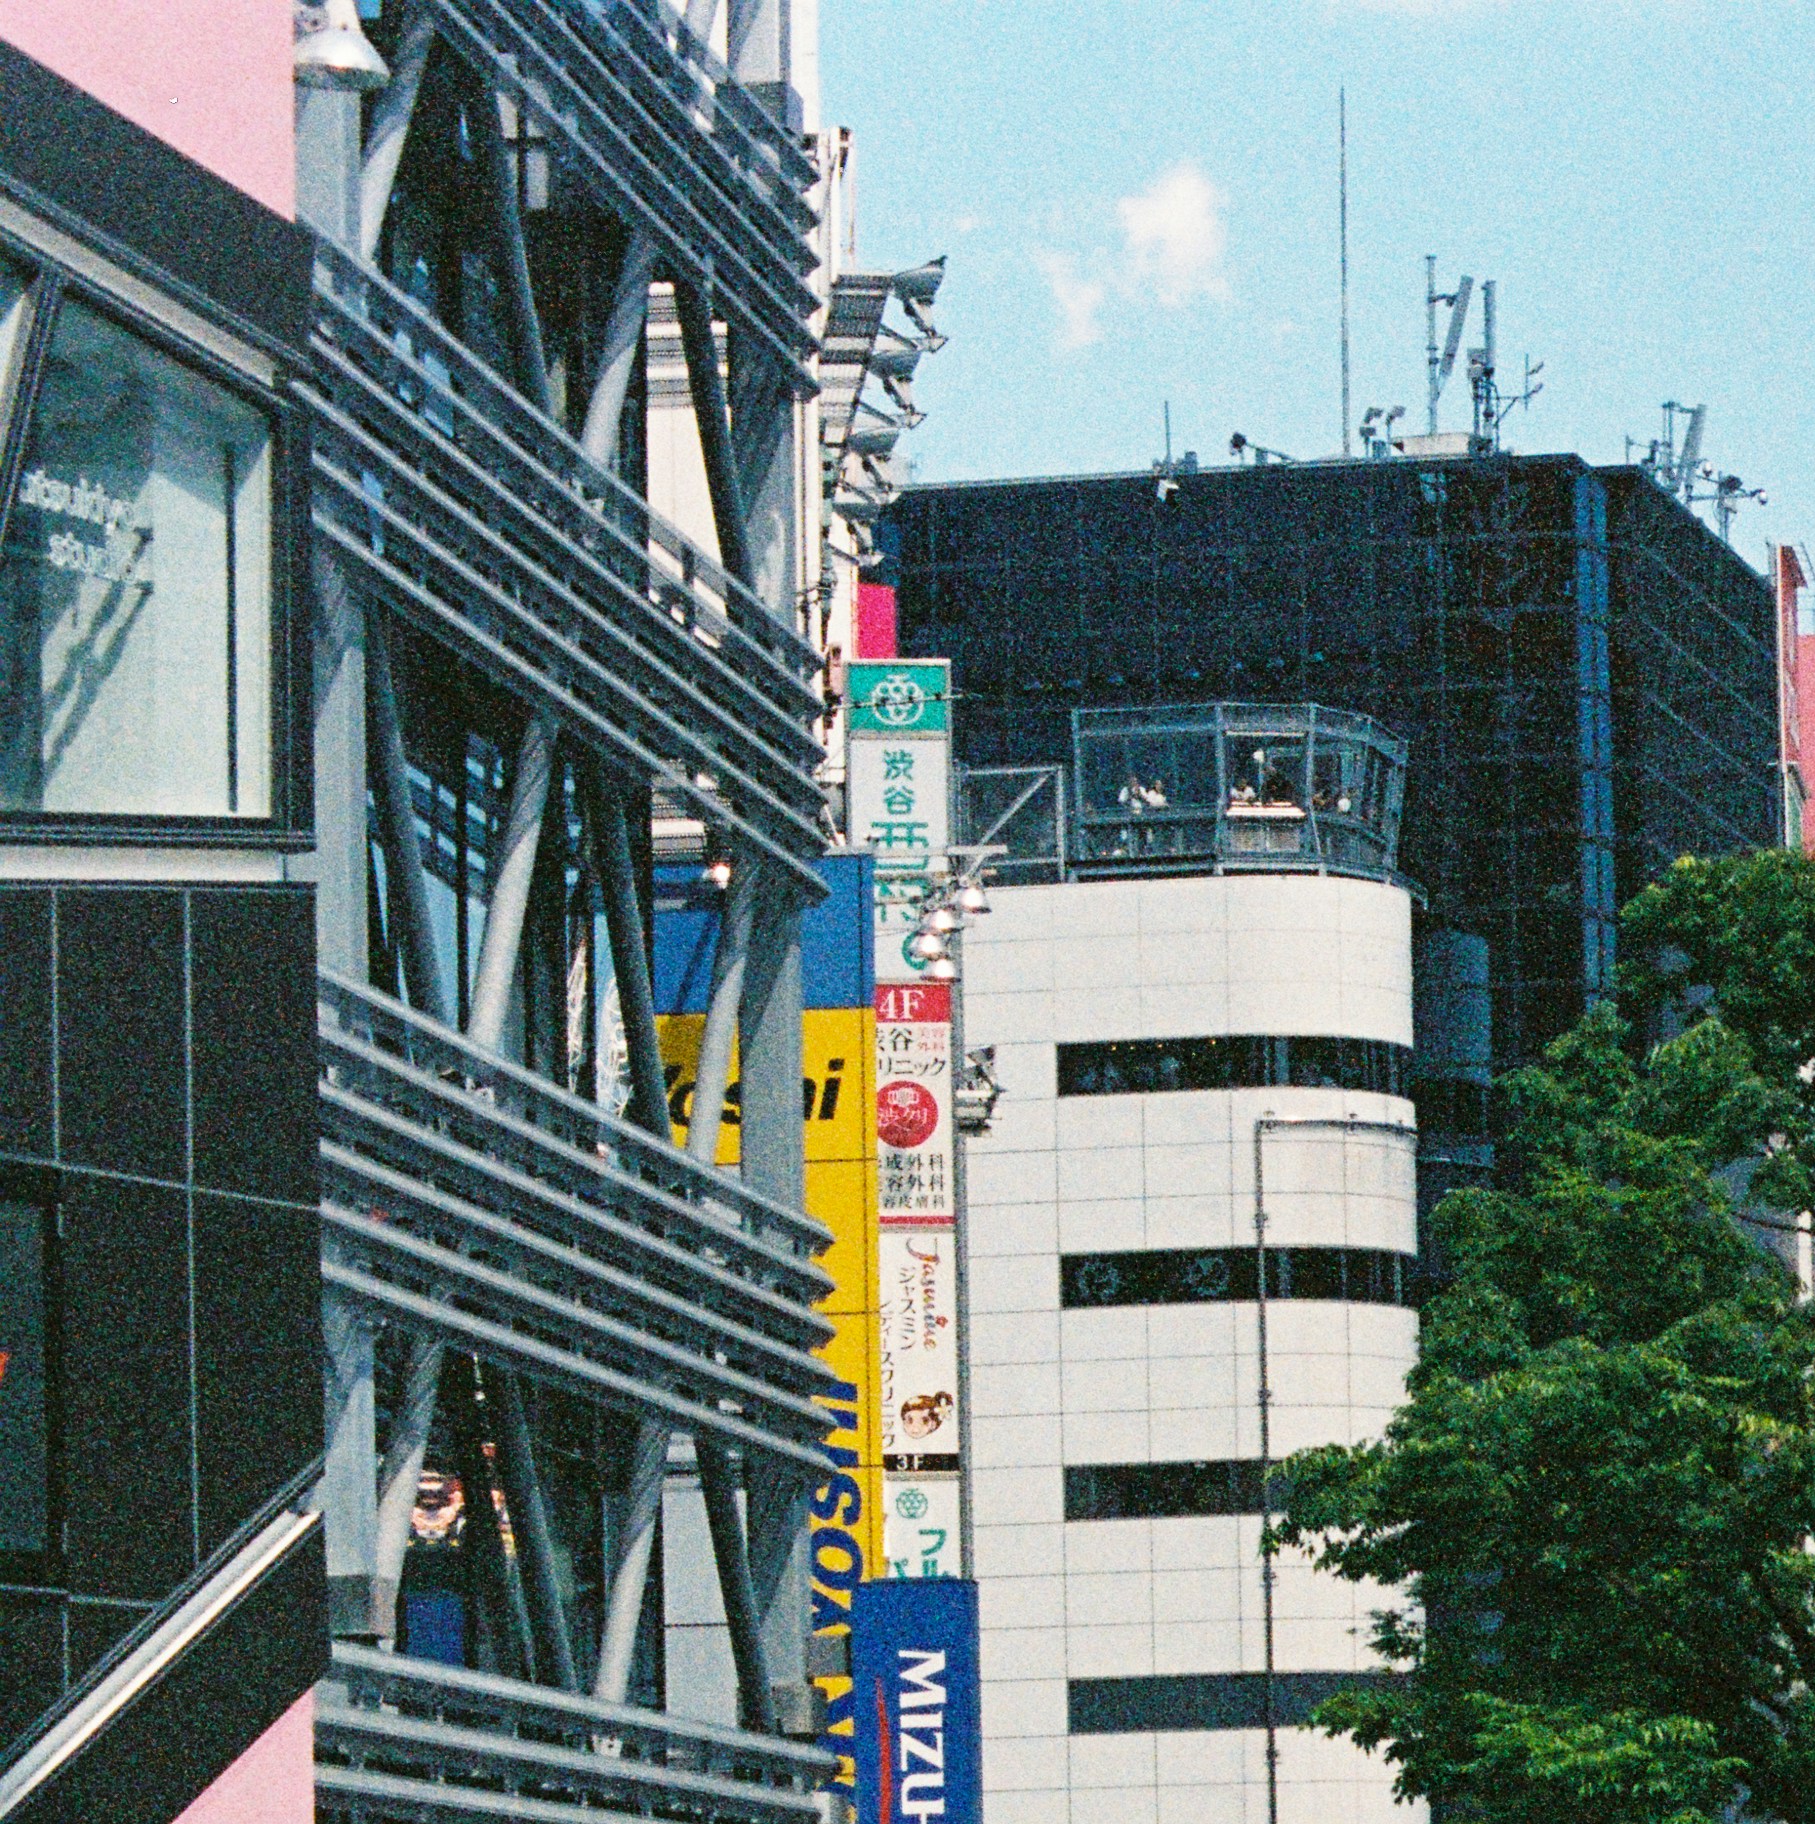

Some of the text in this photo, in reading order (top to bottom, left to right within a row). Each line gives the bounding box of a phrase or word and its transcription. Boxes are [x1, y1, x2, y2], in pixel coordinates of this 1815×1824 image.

[883, 749, 916, 816] 渋谷
[879, 989, 925, 1021] 4F
[878, 1153, 945, 1172] 成外科
[878, 1173, 945, 1193] 容外科
